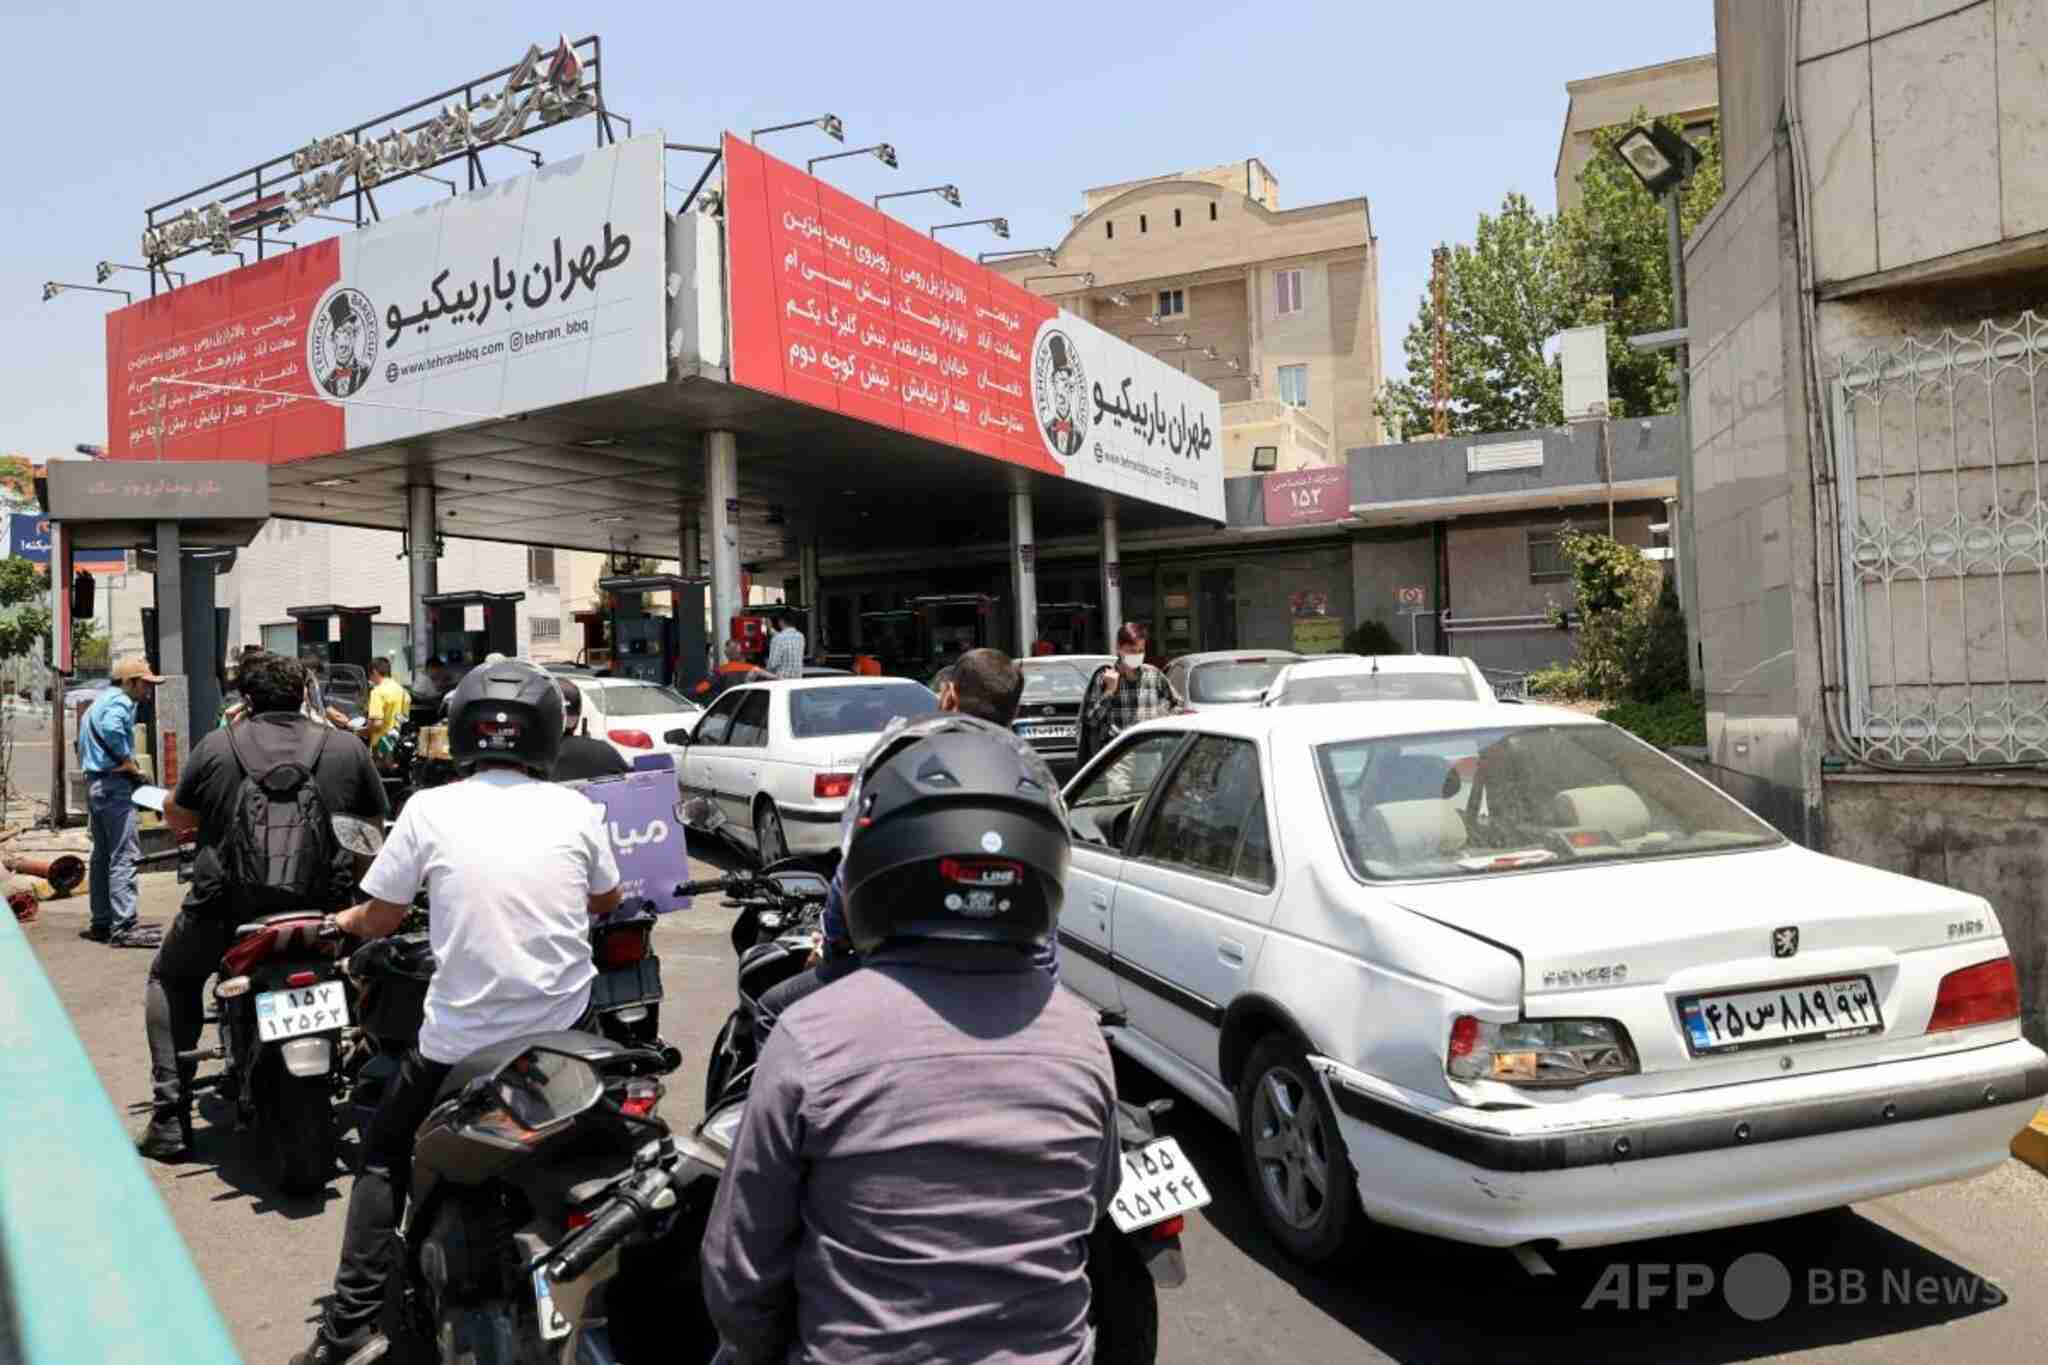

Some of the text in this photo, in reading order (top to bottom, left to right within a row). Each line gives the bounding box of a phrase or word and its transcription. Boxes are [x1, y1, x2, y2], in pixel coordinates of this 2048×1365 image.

[386, 222, 631, 349] طهران باربیکیو
[400, 318, 589, 376] www.tehranbbq.com tehran_bbq
[789, 342, 817, 369] دوم
[860, 361, 890, 392] نبش
[1093, 377, 1167, 446] باربیکیو
[1168, 402, 1212, 460] طهران
[289, 987, 331, 1009] ۱۵۷
[1126, 1147, 1175, 1181] ۱۵۵
